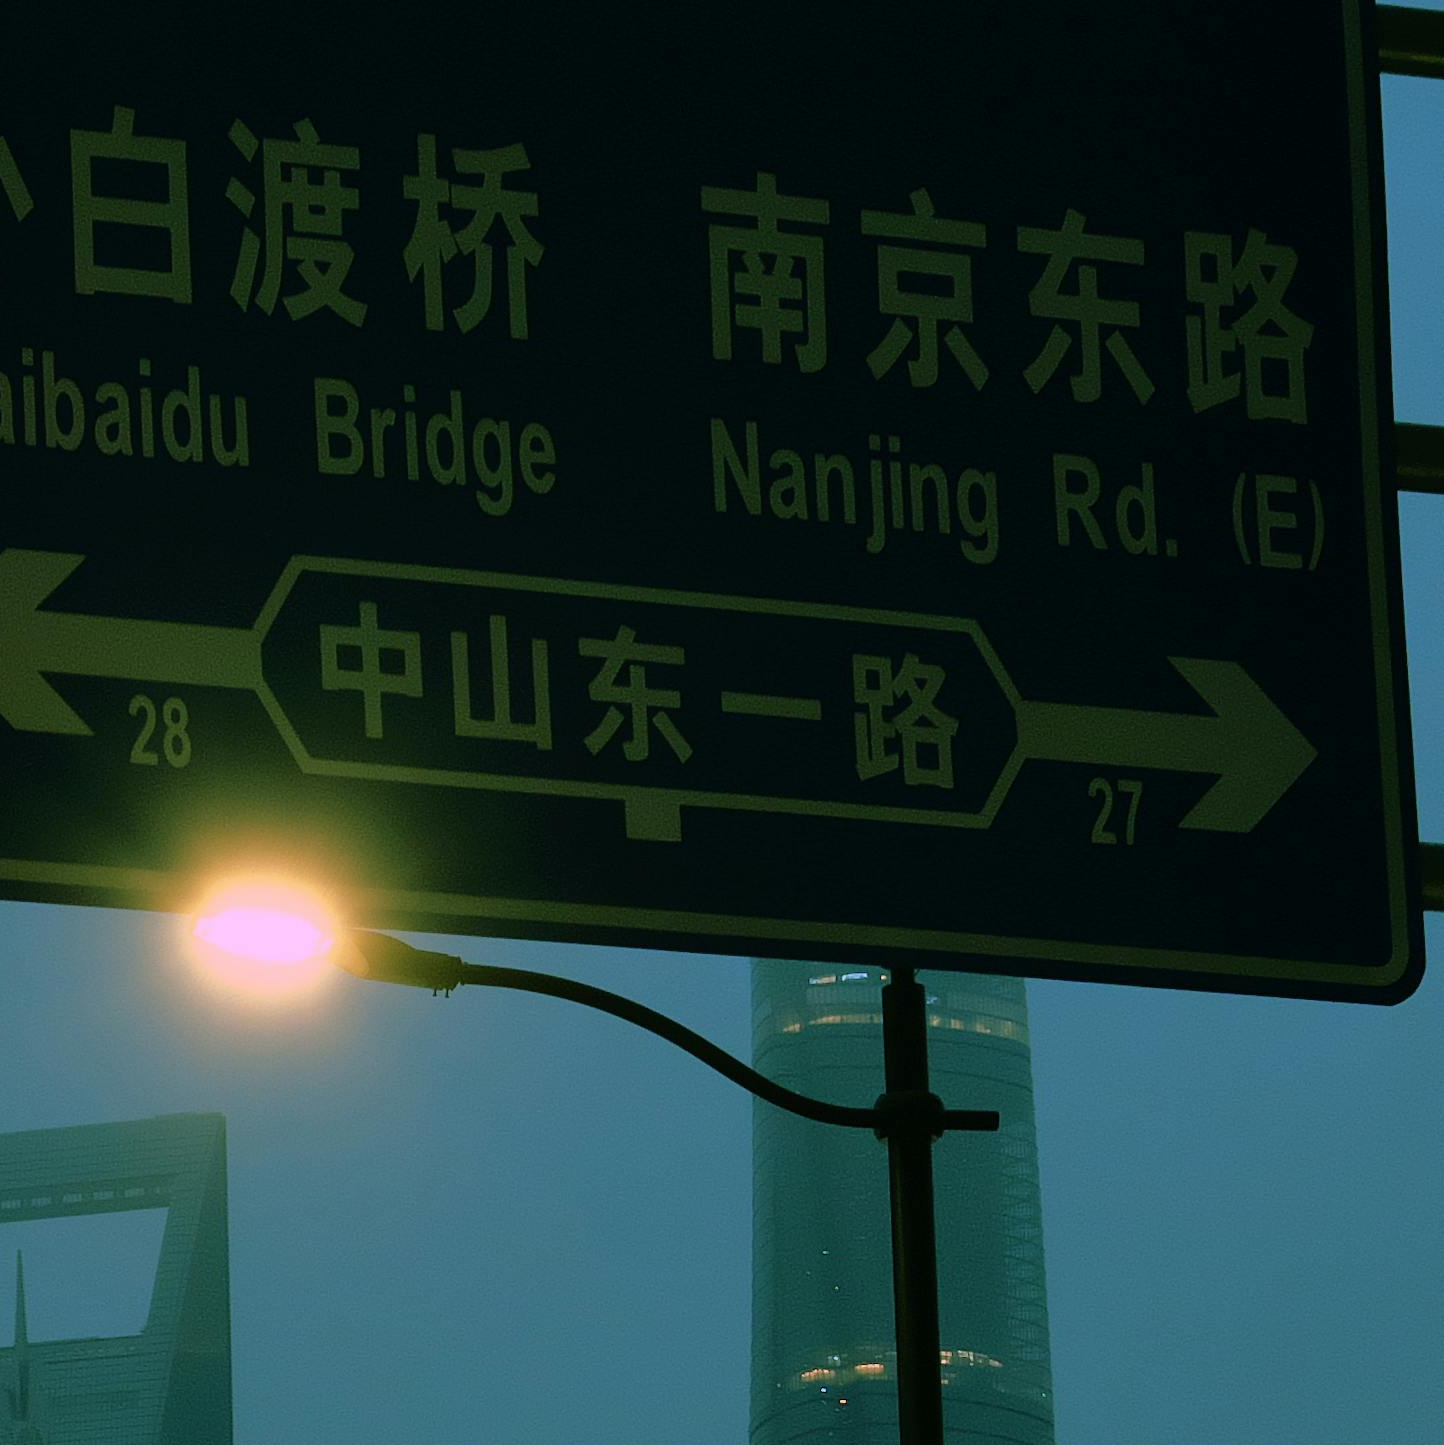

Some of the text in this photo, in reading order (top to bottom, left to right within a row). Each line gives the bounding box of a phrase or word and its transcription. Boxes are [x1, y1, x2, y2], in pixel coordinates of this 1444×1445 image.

[699, 170, 1314, 426] 南京东路
[313, 379, 557, 518] Bridge
[709, 416, 1325, 574] Nanjing Rd. (E)
[126, 696, 192, 769] 28
[318, 602, 960, 791] 中山东一路
[1089, 779, 1144, 847] 27
